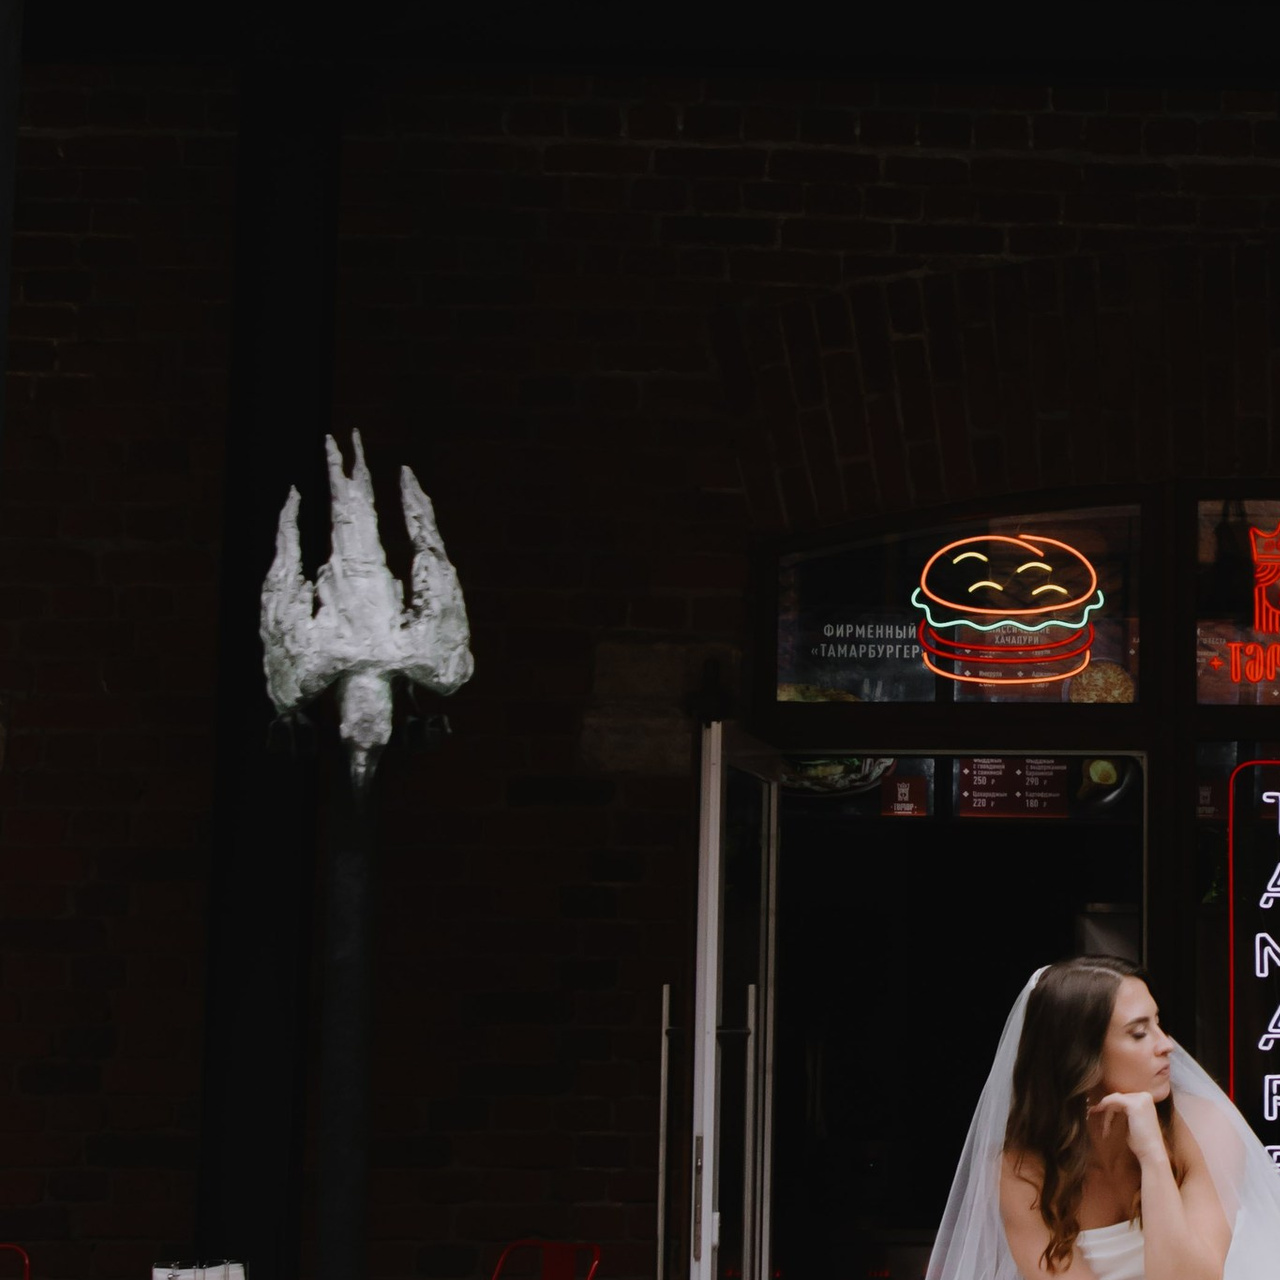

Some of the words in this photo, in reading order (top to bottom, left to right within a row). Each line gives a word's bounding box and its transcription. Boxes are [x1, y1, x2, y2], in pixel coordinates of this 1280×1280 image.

[823, 623, 917, 639] ФИРМЕННЫЙ
[994, 635, 1040, 645] ХАЧАПУРИ
[973, 776, 987, 786] 250
[1025, 777, 1039, 786] 290
[972, 798, 986, 808] 220
[1025, 799, 1039, 808] 180
